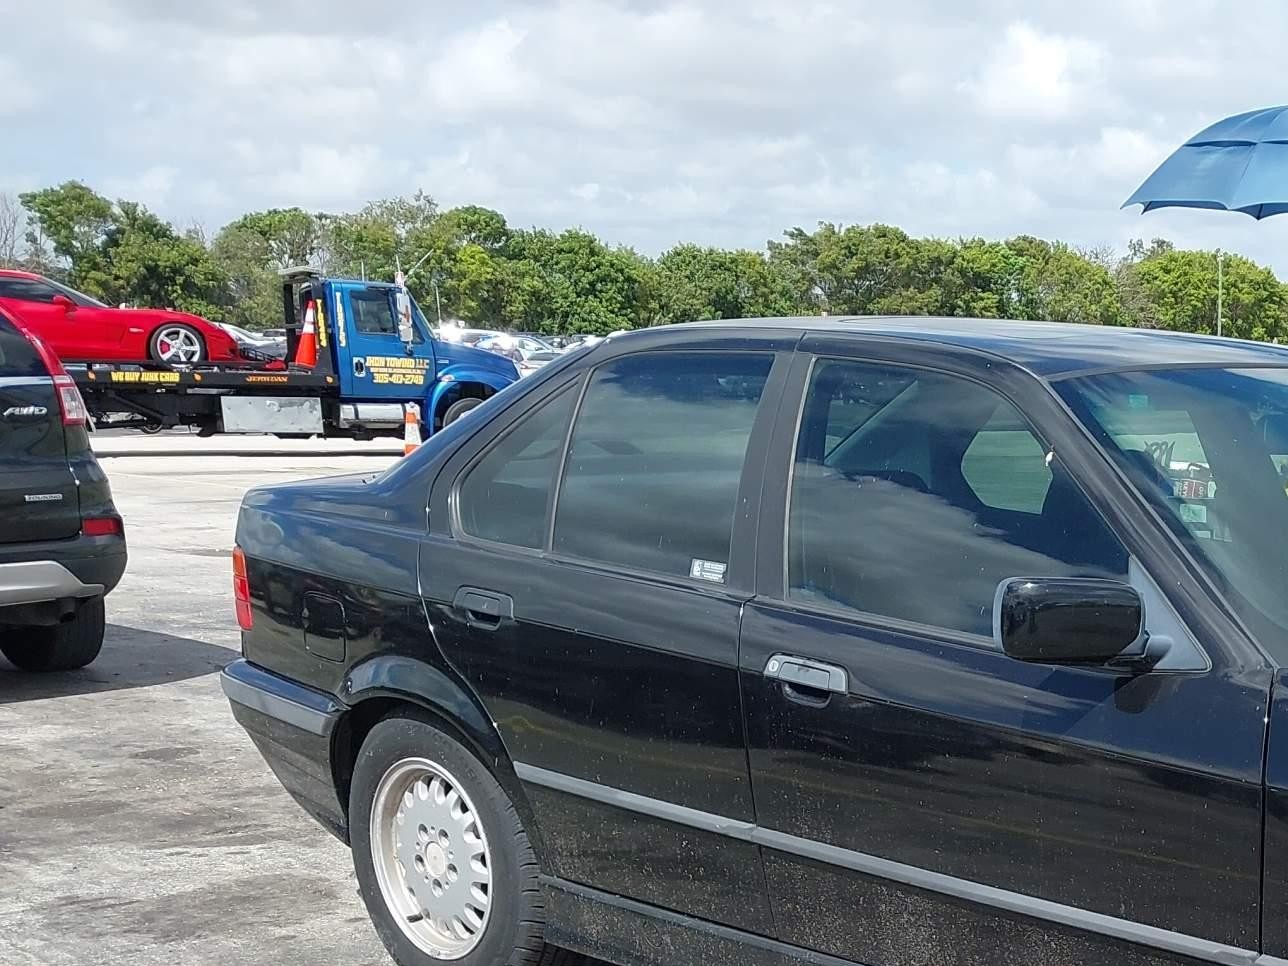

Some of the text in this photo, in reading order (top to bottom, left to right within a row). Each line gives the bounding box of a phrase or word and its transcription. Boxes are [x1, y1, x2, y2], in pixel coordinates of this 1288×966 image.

[416, 358, 430, 369] LLC
[111, 371, 180, 383] WE BUY JUNK CARS
[3, 406, 48, 416] AWD
